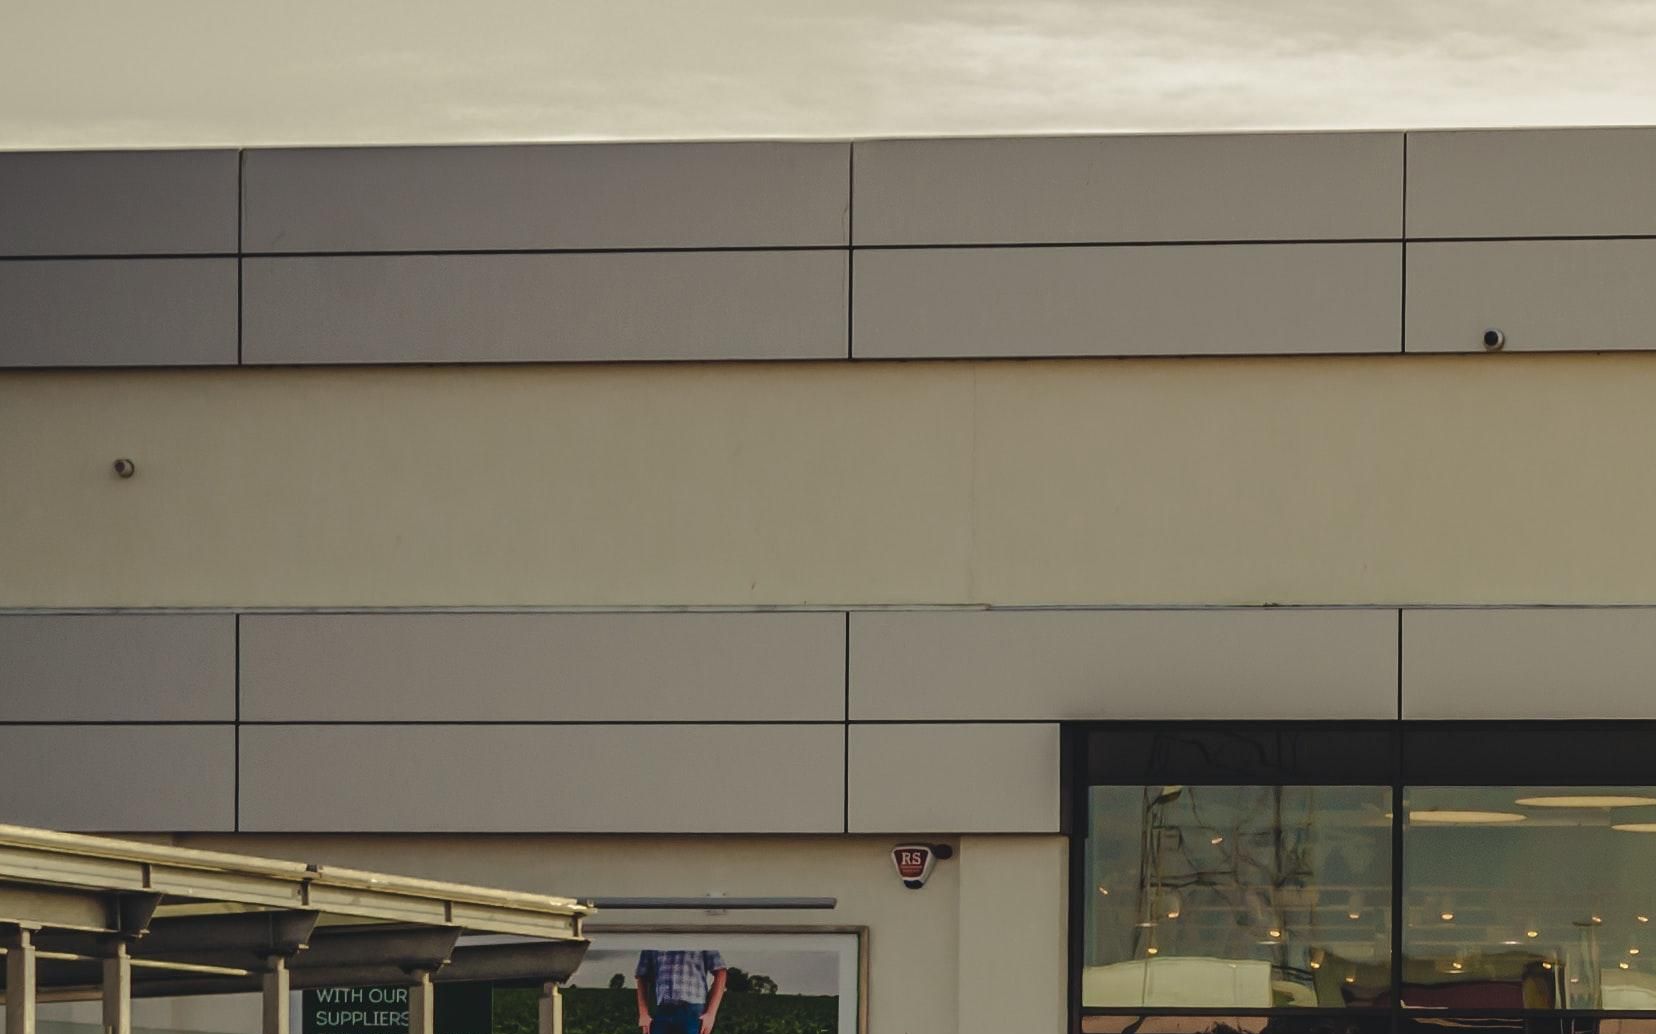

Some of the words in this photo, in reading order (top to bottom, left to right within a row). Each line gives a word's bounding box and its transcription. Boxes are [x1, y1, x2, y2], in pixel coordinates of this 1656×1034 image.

[902, 852, 921, 865] RS
[316, 989, 363, 1003] WITH
[369, 988, 408, 1003] OUR
[316, 1011, 409, 1026] SUPPLIERS
